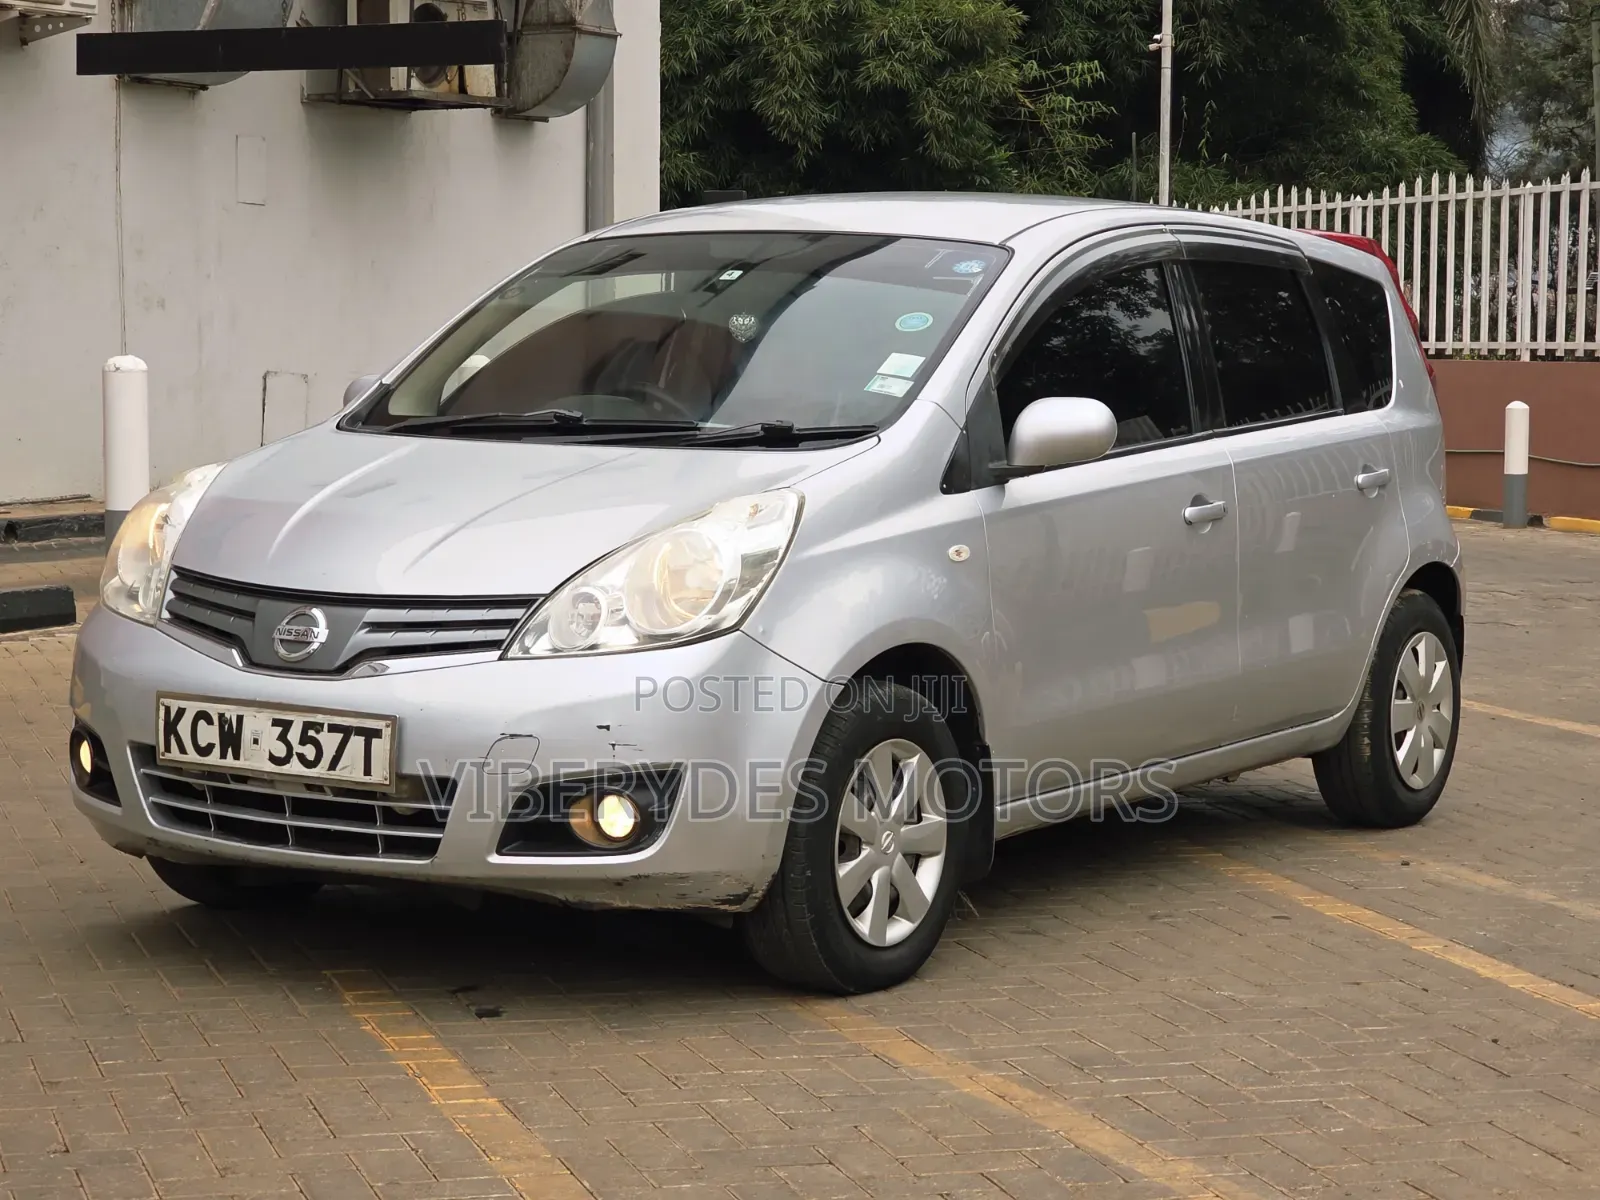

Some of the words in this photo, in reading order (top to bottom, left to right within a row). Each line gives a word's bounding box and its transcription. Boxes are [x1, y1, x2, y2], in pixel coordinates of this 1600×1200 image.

[275, 627, 320, 639] NISSAN
[162, 705, 245, 761] KCW
[267, 717, 383, 777] 357T
